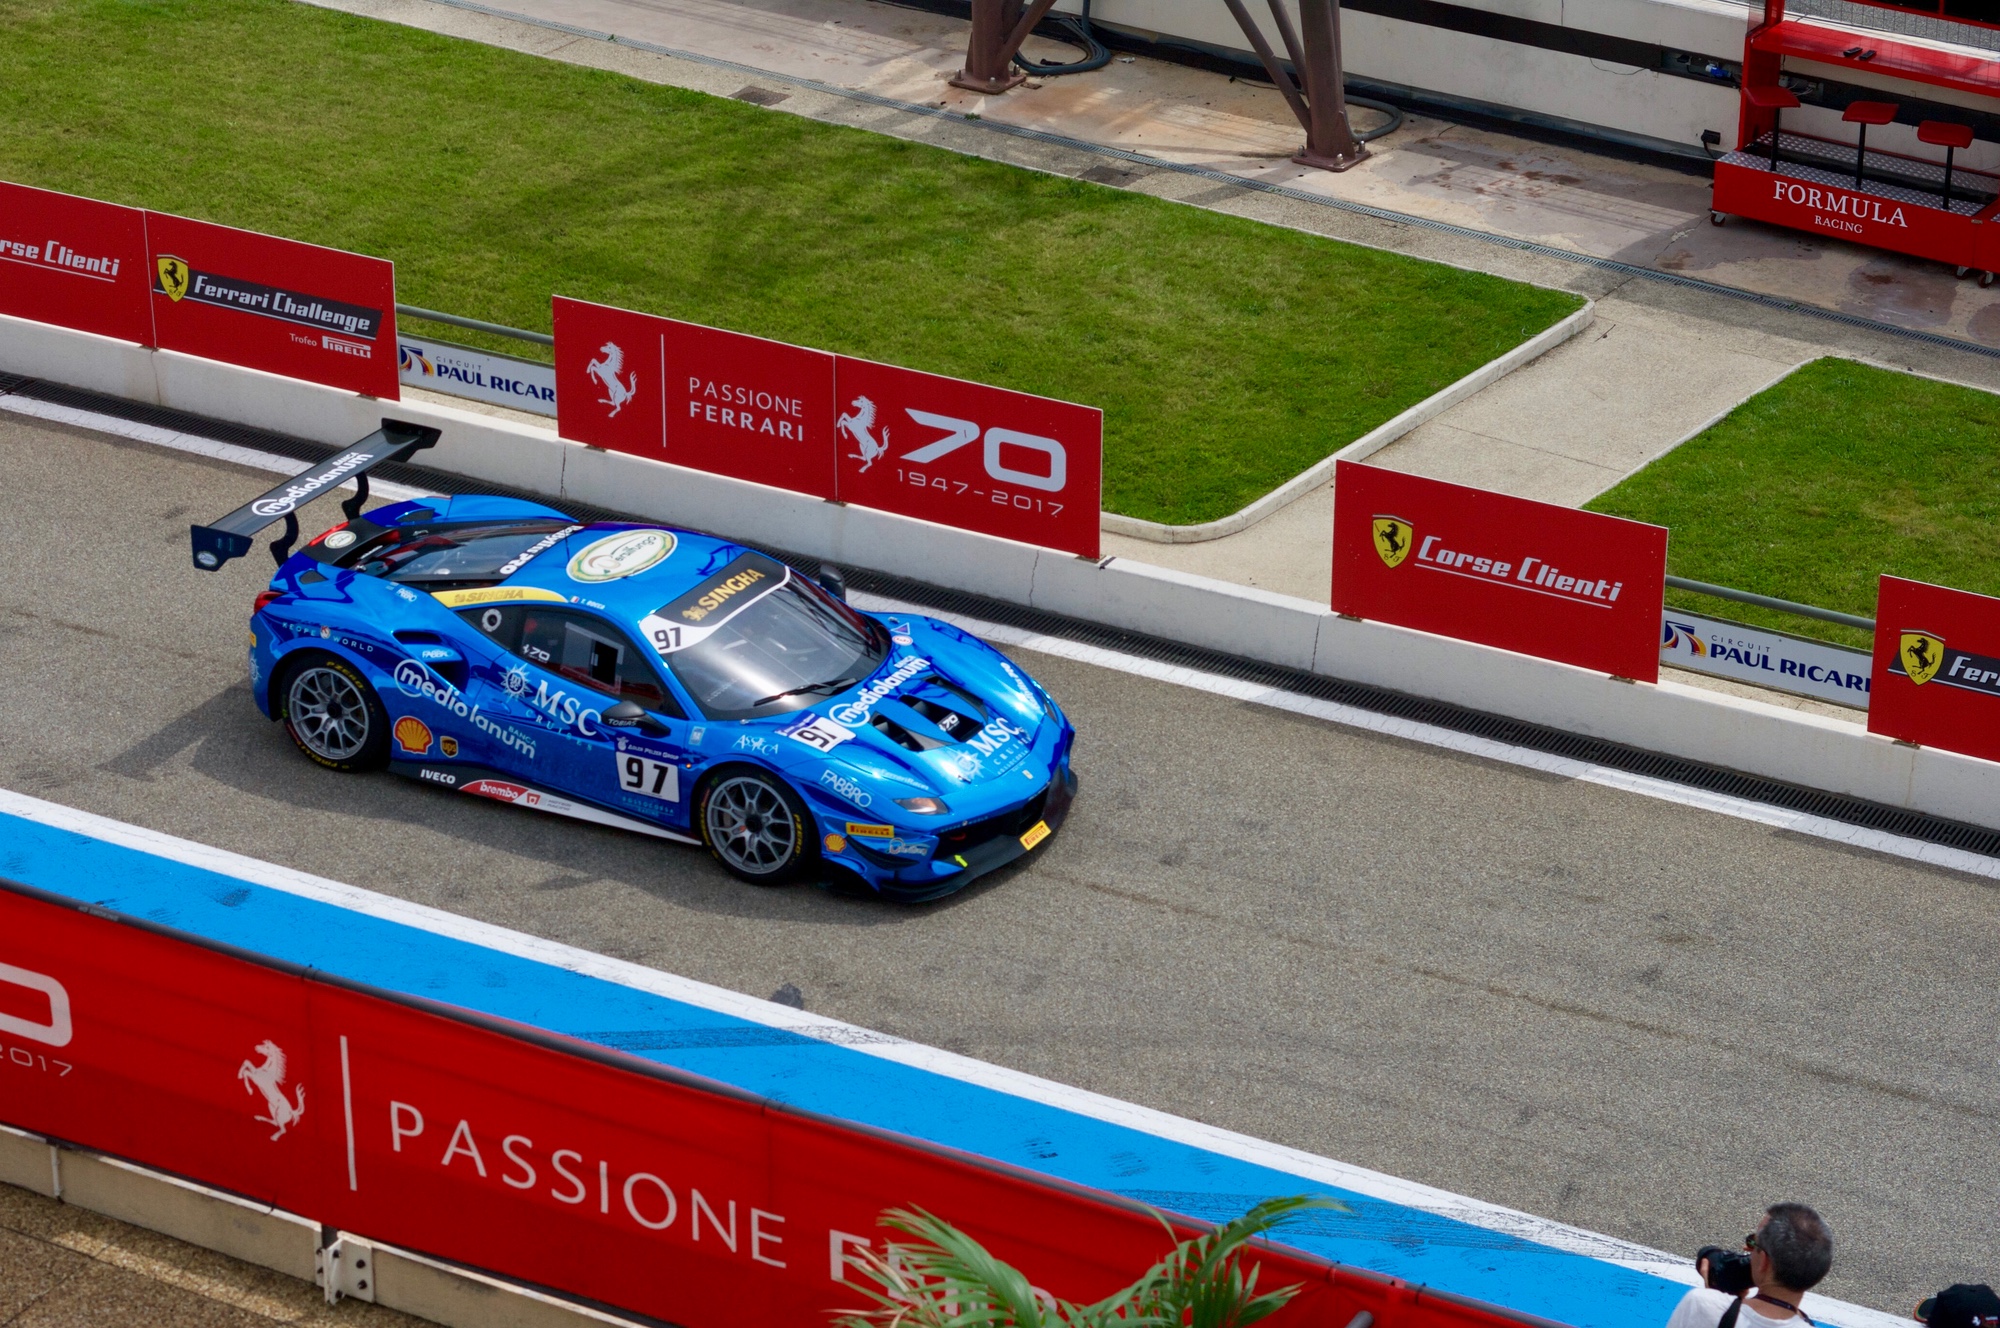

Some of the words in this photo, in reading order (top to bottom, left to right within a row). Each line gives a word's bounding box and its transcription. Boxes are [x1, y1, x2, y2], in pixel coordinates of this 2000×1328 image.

[1773, 180, 1908, 228] FORMULA
[1814, 215, 1863, 235] RACING
[44, 240, 120, 276] Clienti
[194, 275, 269, 309] Ferrari
[273, 292, 371, 333] Challenge
[289, 333, 317, 347] Trofeo
[322, 335, 372, 359] PIRELLI
[436, 355, 482, 371] CIRCUIT
[436, 363, 487, 388] PAUL
[490, 375, 556, 402] RICAR
[688, 376, 804, 418] PASSIONE
[689, 401, 804, 442] FERRARI
[900, 407, 1067, 493] 70
[259, 453, 374, 514] mediolanum
[897, 469, 1065, 516] 1947-2017
[1417, 535, 1512, 577] Corse
[1516, 557, 1623, 602] Clienti
[466, 589, 524, 603] SINGHA
[698, 568, 766, 612] SINGHA
[282, 621, 317, 637] KEOPE
[333, 635, 374, 652] WORLD
[530, 646, 551, 661] 70
[654, 627, 682, 651] 97
[1711, 635, 1770, 653] CIRCUIT
[1710, 643, 1775, 672] PAUL
[531, 679, 602, 737] MSC
[837, 657, 931, 724] mediolanum
[399, 666, 536, 760] mediolanum
[525, 709, 593, 752] CRUISES
[608, 718, 637, 727] TOBIAS
[508, 726, 537, 747] BANCA
[796, 725, 838, 749] 97
[966, 717, 1020, 757] MSC
[420, 768, 456, 785] IVECO
[480, 782, 519, 799] brembo
[625, 757, 669, 794] 97
[820, 769, 872, 807] FABBRO
[850, 825, 890, 836] PIRELLI
[1024, 824, 1047, 846] PIRELLI
[0, 1044, 73, 1077] 017
[388, 1099, 788, 1271] PASSIONE
